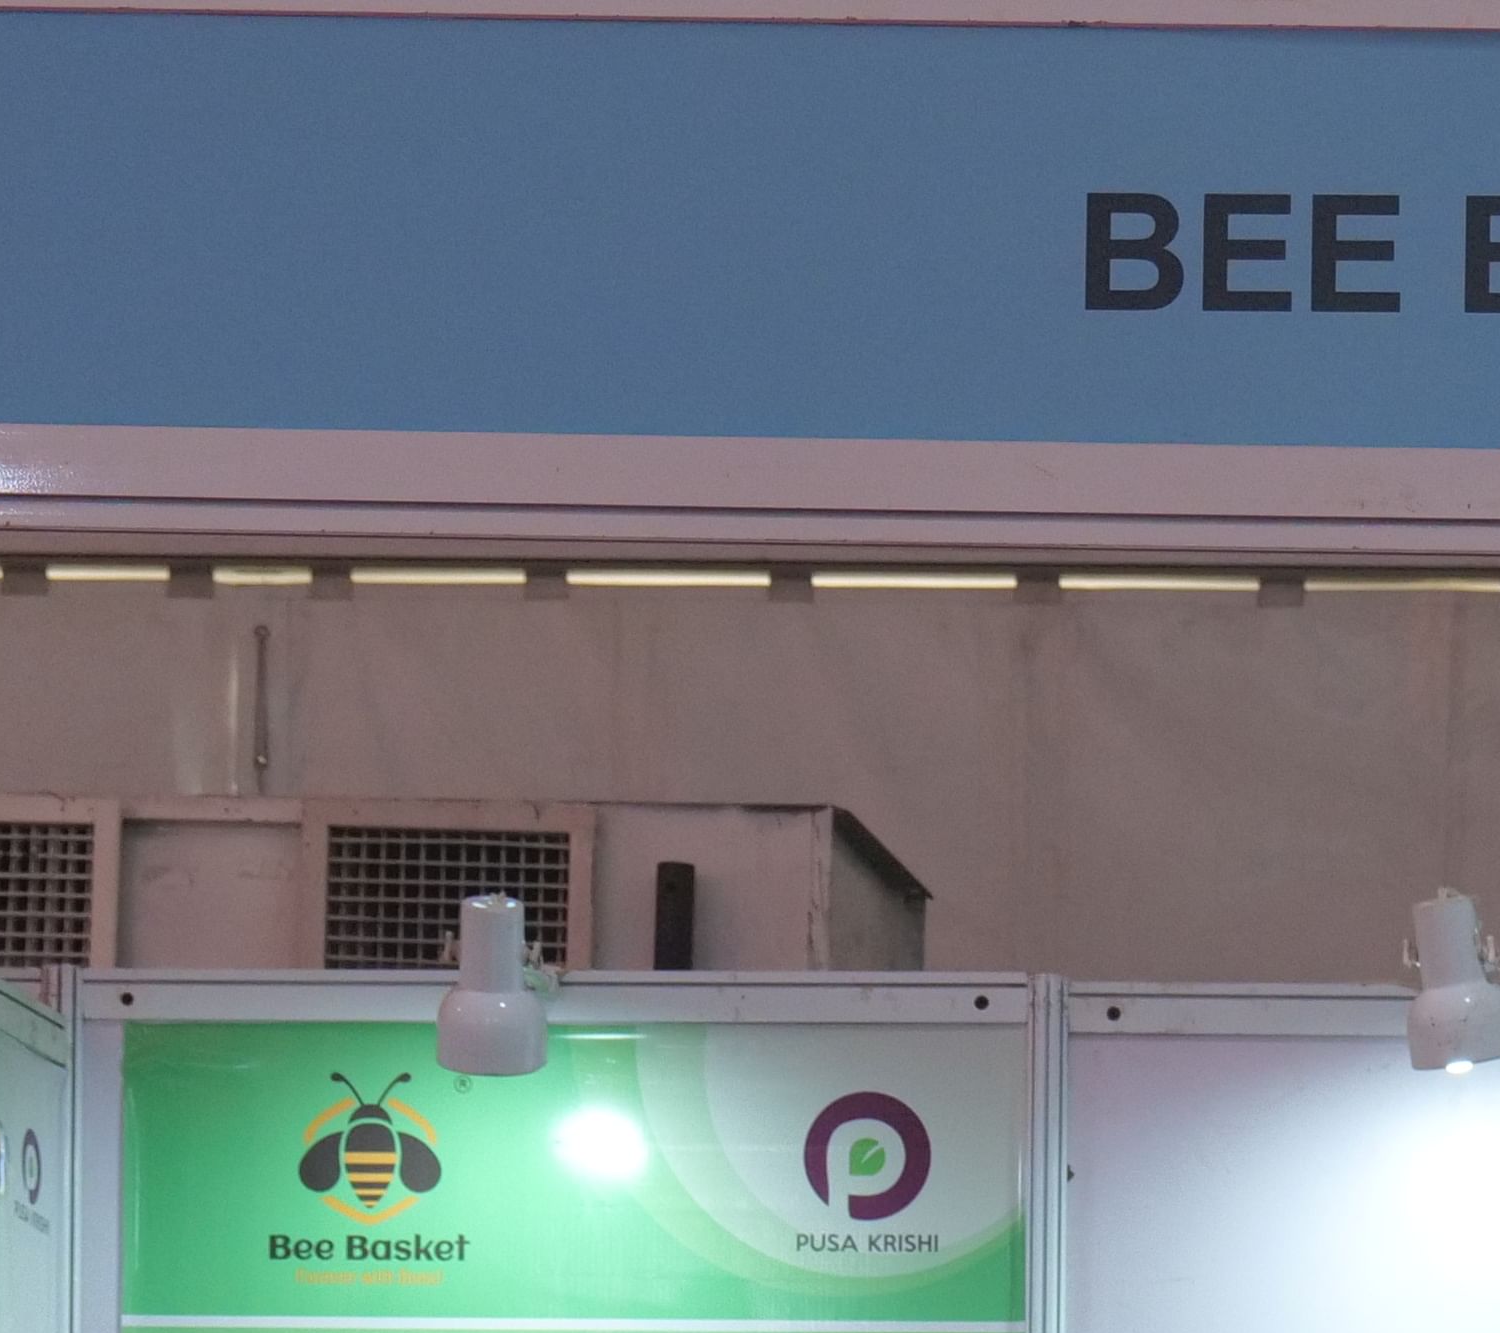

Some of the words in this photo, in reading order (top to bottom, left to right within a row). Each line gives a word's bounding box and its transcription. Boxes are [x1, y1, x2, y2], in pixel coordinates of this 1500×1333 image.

[1085, 193, 1400, 312] BEE
[269, 1235, 333, 1260] Bee
[346, 1235, 469, 1261] Basket
[797, 1234, 858, 1252] PUSA
[869, 1235, 938, 1252] KRISHI
